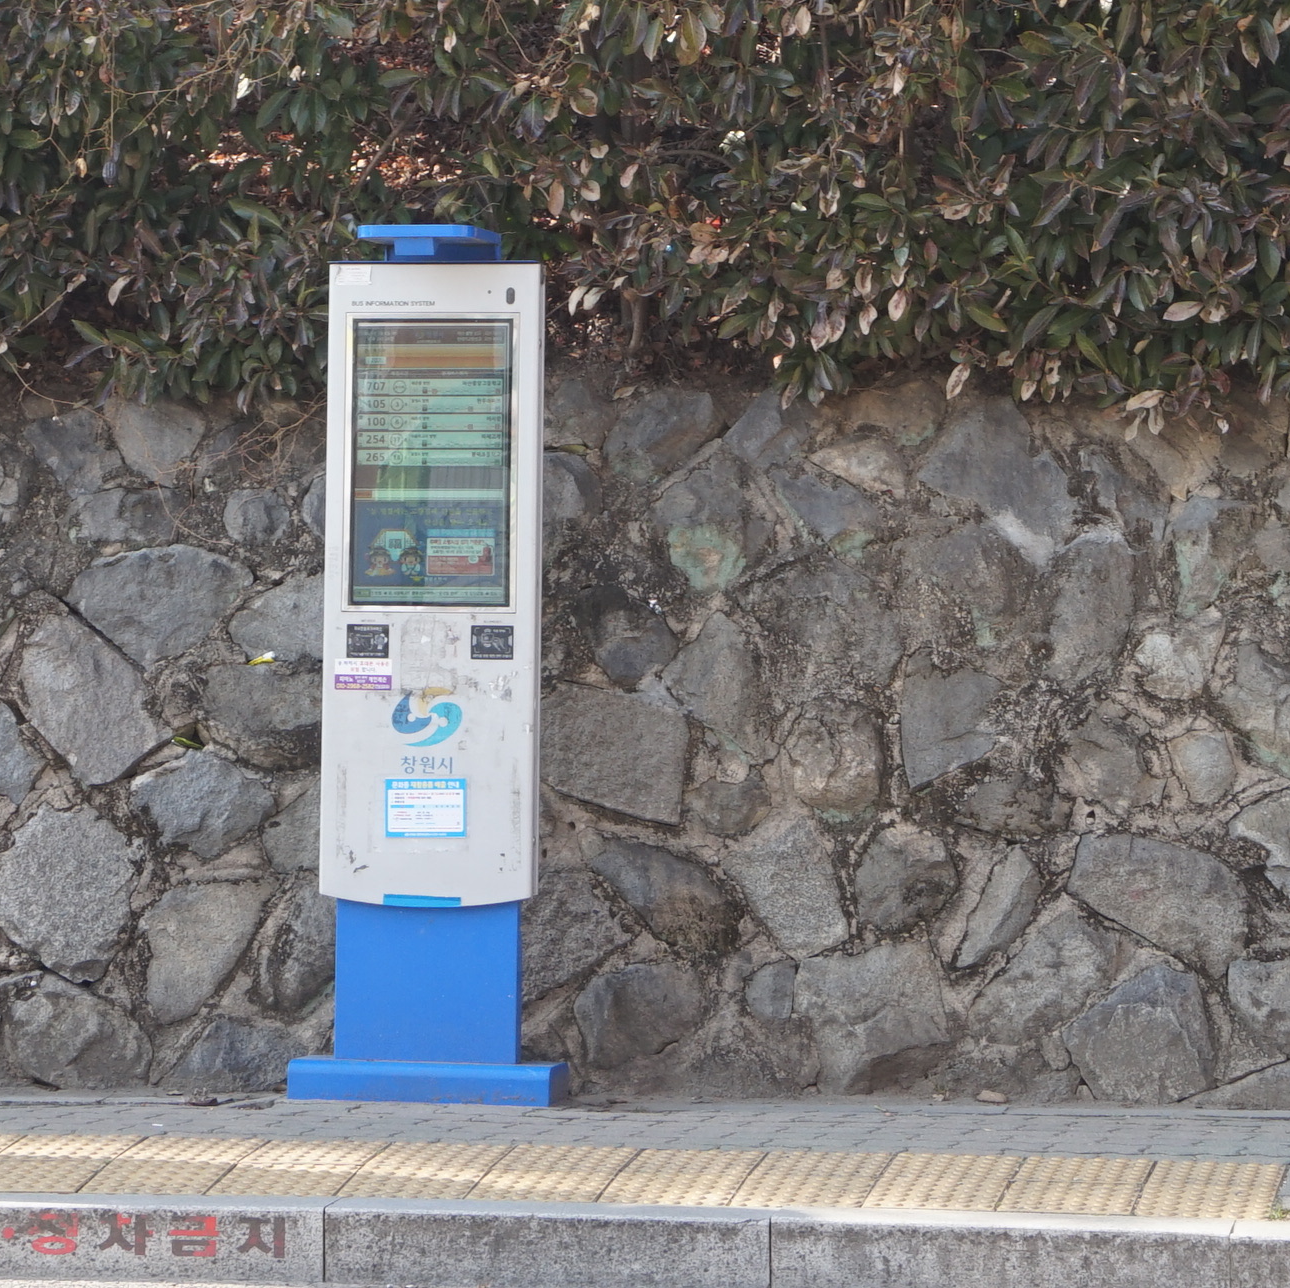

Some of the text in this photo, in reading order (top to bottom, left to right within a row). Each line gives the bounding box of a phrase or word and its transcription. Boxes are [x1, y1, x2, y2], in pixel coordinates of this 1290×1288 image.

[367, 382, 385, 391] 707
[368, 400, 385, 408] 105
[367, 418, 385, 426] 100
[366, 435, 385, 444] 254
[366, 453, 385, 462] 265
[401, 756, 453, 774] 창원시
